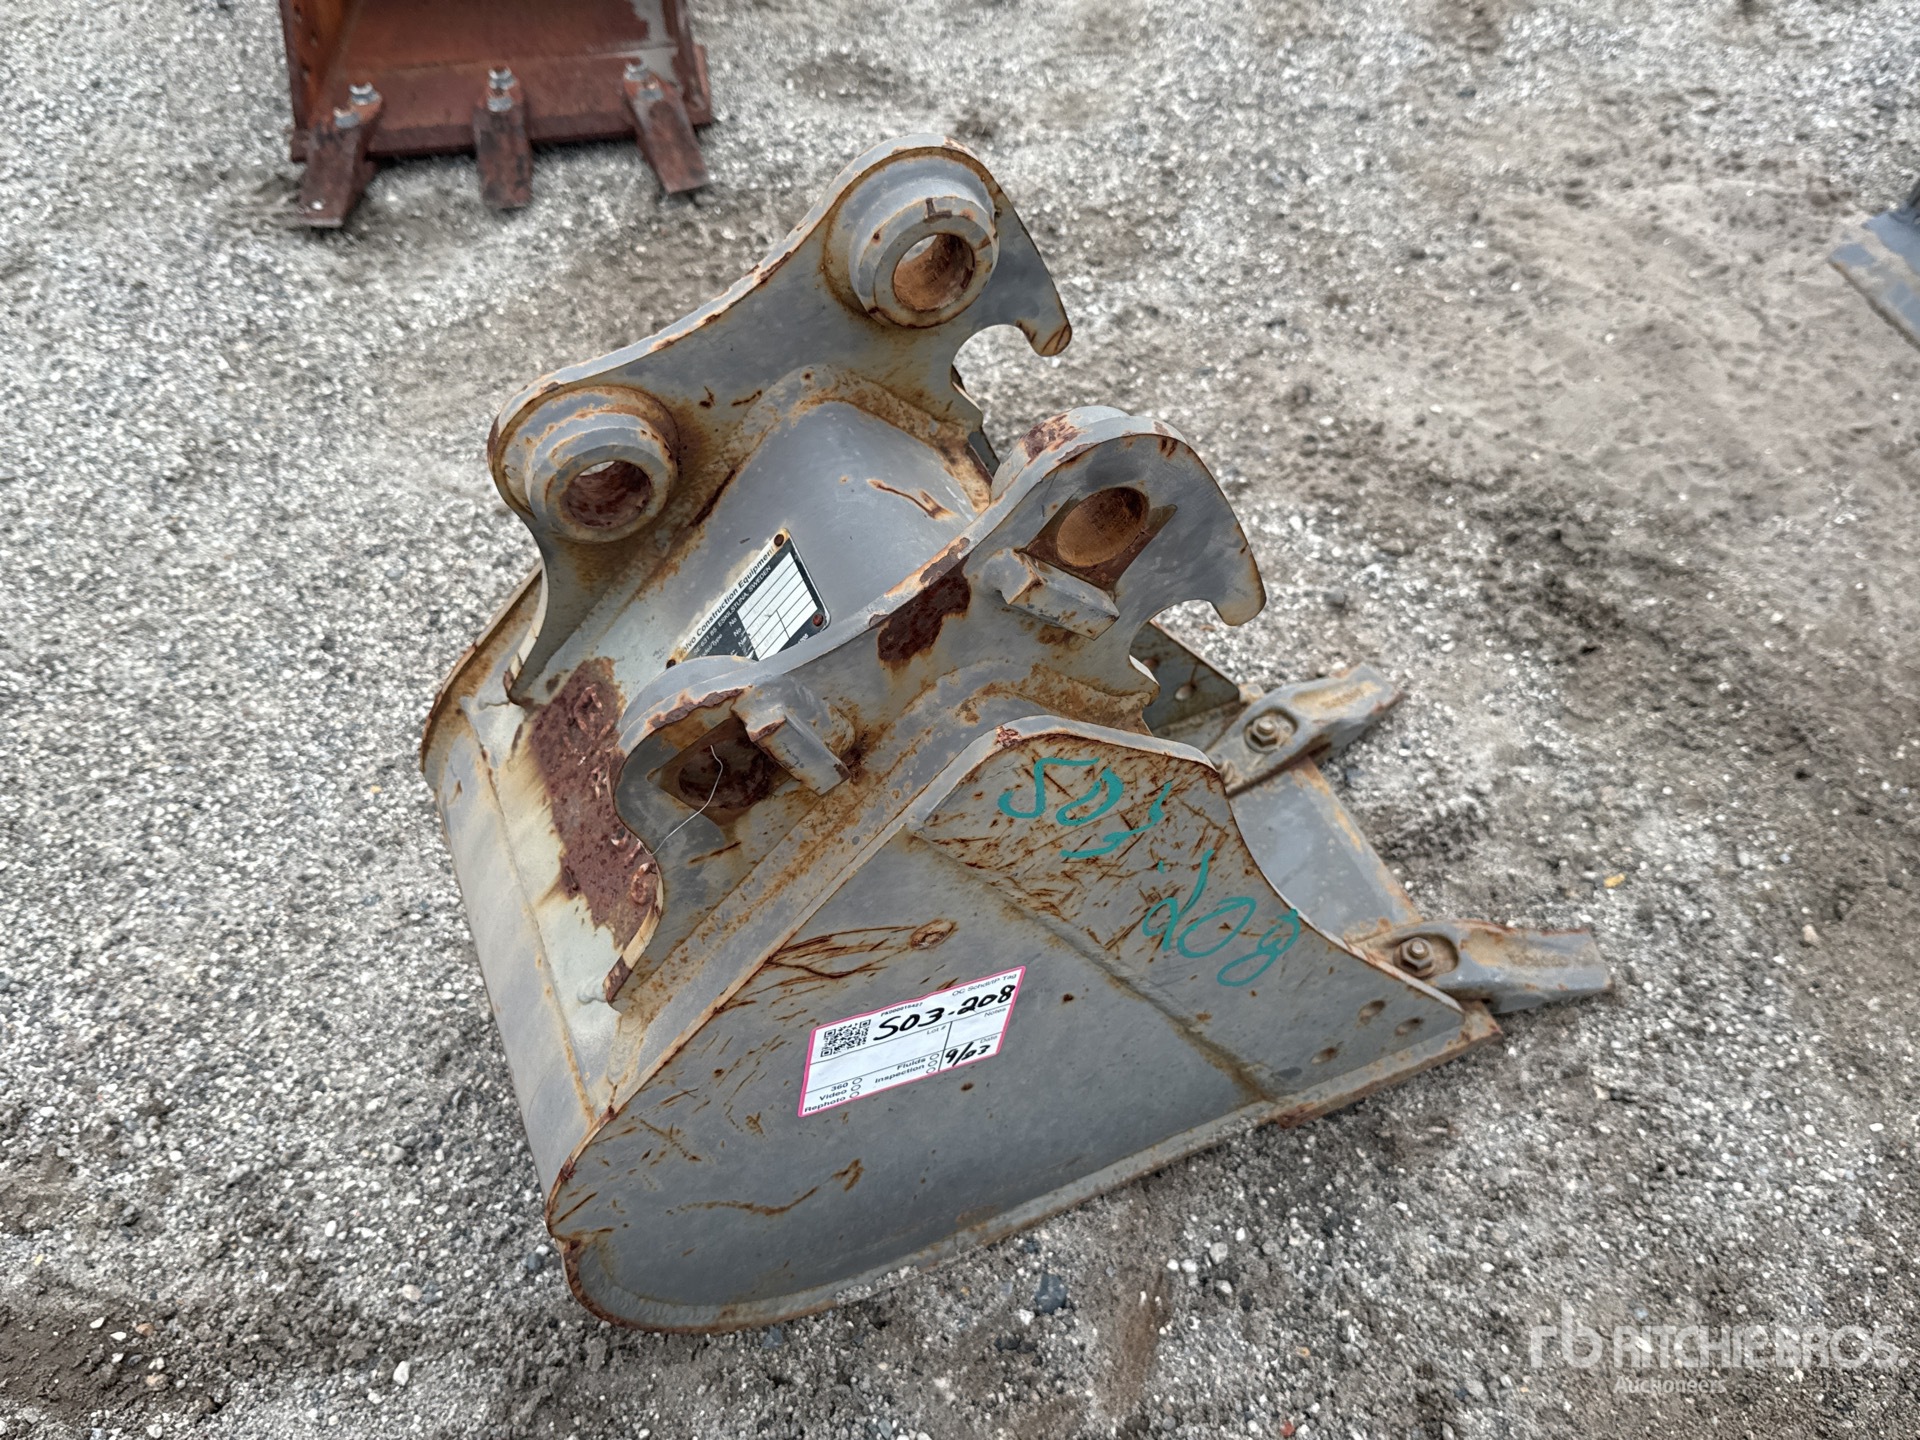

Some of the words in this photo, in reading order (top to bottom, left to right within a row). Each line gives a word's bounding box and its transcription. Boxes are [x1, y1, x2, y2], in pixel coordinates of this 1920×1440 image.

[748, 565, 772, 593] SWEDEN
[696, 589, 739, 637] Construction
[1002, 973, 1018, 982] Tag
[984, 1007, 1007, 1018] Notes
[980, 1035, 998, 1044] Date
[896, 1057, 926, 1070] Fluids
[874, 1063, 925, 1084] Inspection
[830, 1082, 849, 1092] 360
[819, 1089, 847, 1101] Video
[804, 1096, 846, 1113] Rephoto
